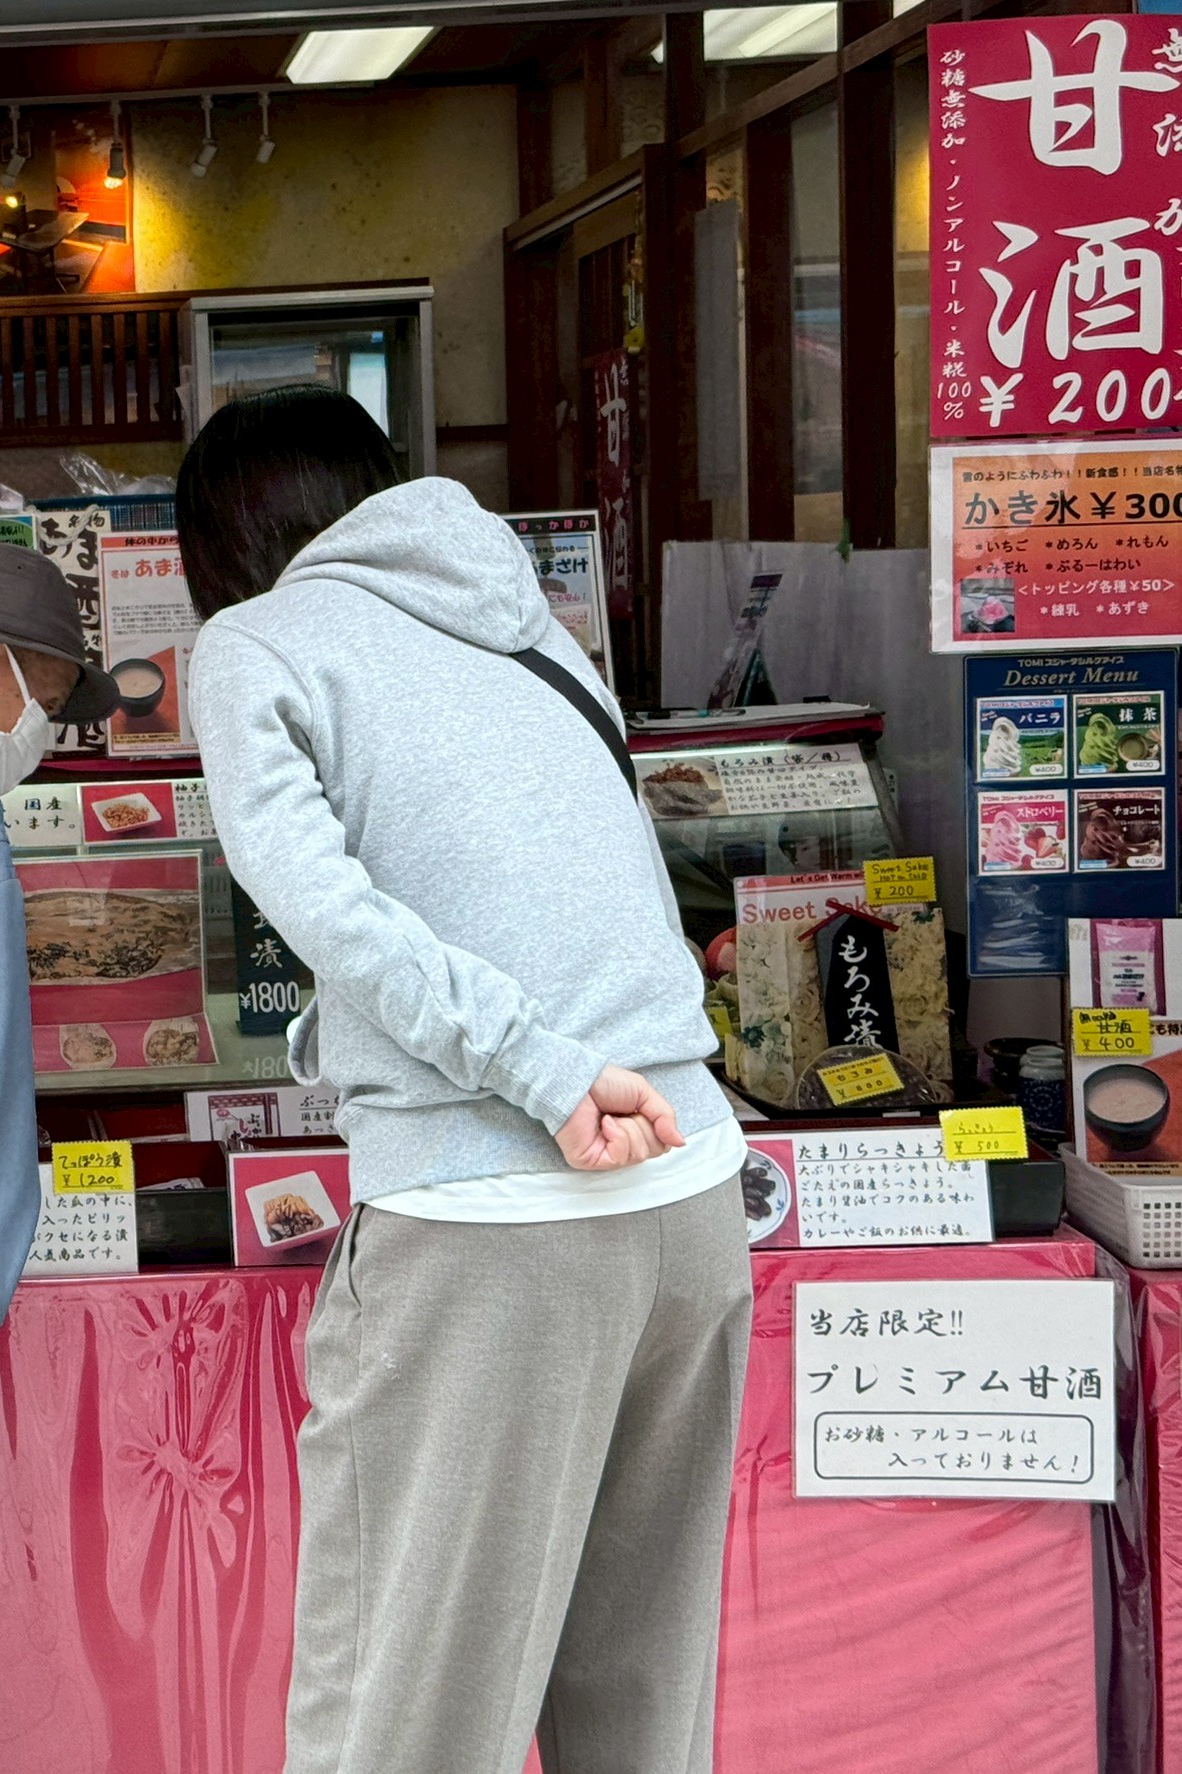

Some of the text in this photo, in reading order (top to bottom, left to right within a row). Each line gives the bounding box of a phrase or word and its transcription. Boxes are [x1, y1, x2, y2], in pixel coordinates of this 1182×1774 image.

[1003, 667, 1139, 686] Dessert Menu
[1019, 712, 1061, 724] バニラ
[1017, 807, 1064, 818] ストロベリー
[1113, 804, 1160, 816] チョコレート
[742, 901, 817, 925] Sweet
[239, 981, 301, 1013] ¥1800
[798, 1141, 944, 1160] たまりらっきょう
[801, 1177, 954, 1192] ごたえの国産らっきょう。
[802, 1212, 847, 1225] いです。
[29, 1246, 122, 1261] 人気商品です。
[807, 1363, 1103, 1401] プレミアム甘酒
[824, 1424, 1039, 1445] お砂糖・アルコールは
[888, 1452, 1080, 1475] 入っておりません！
